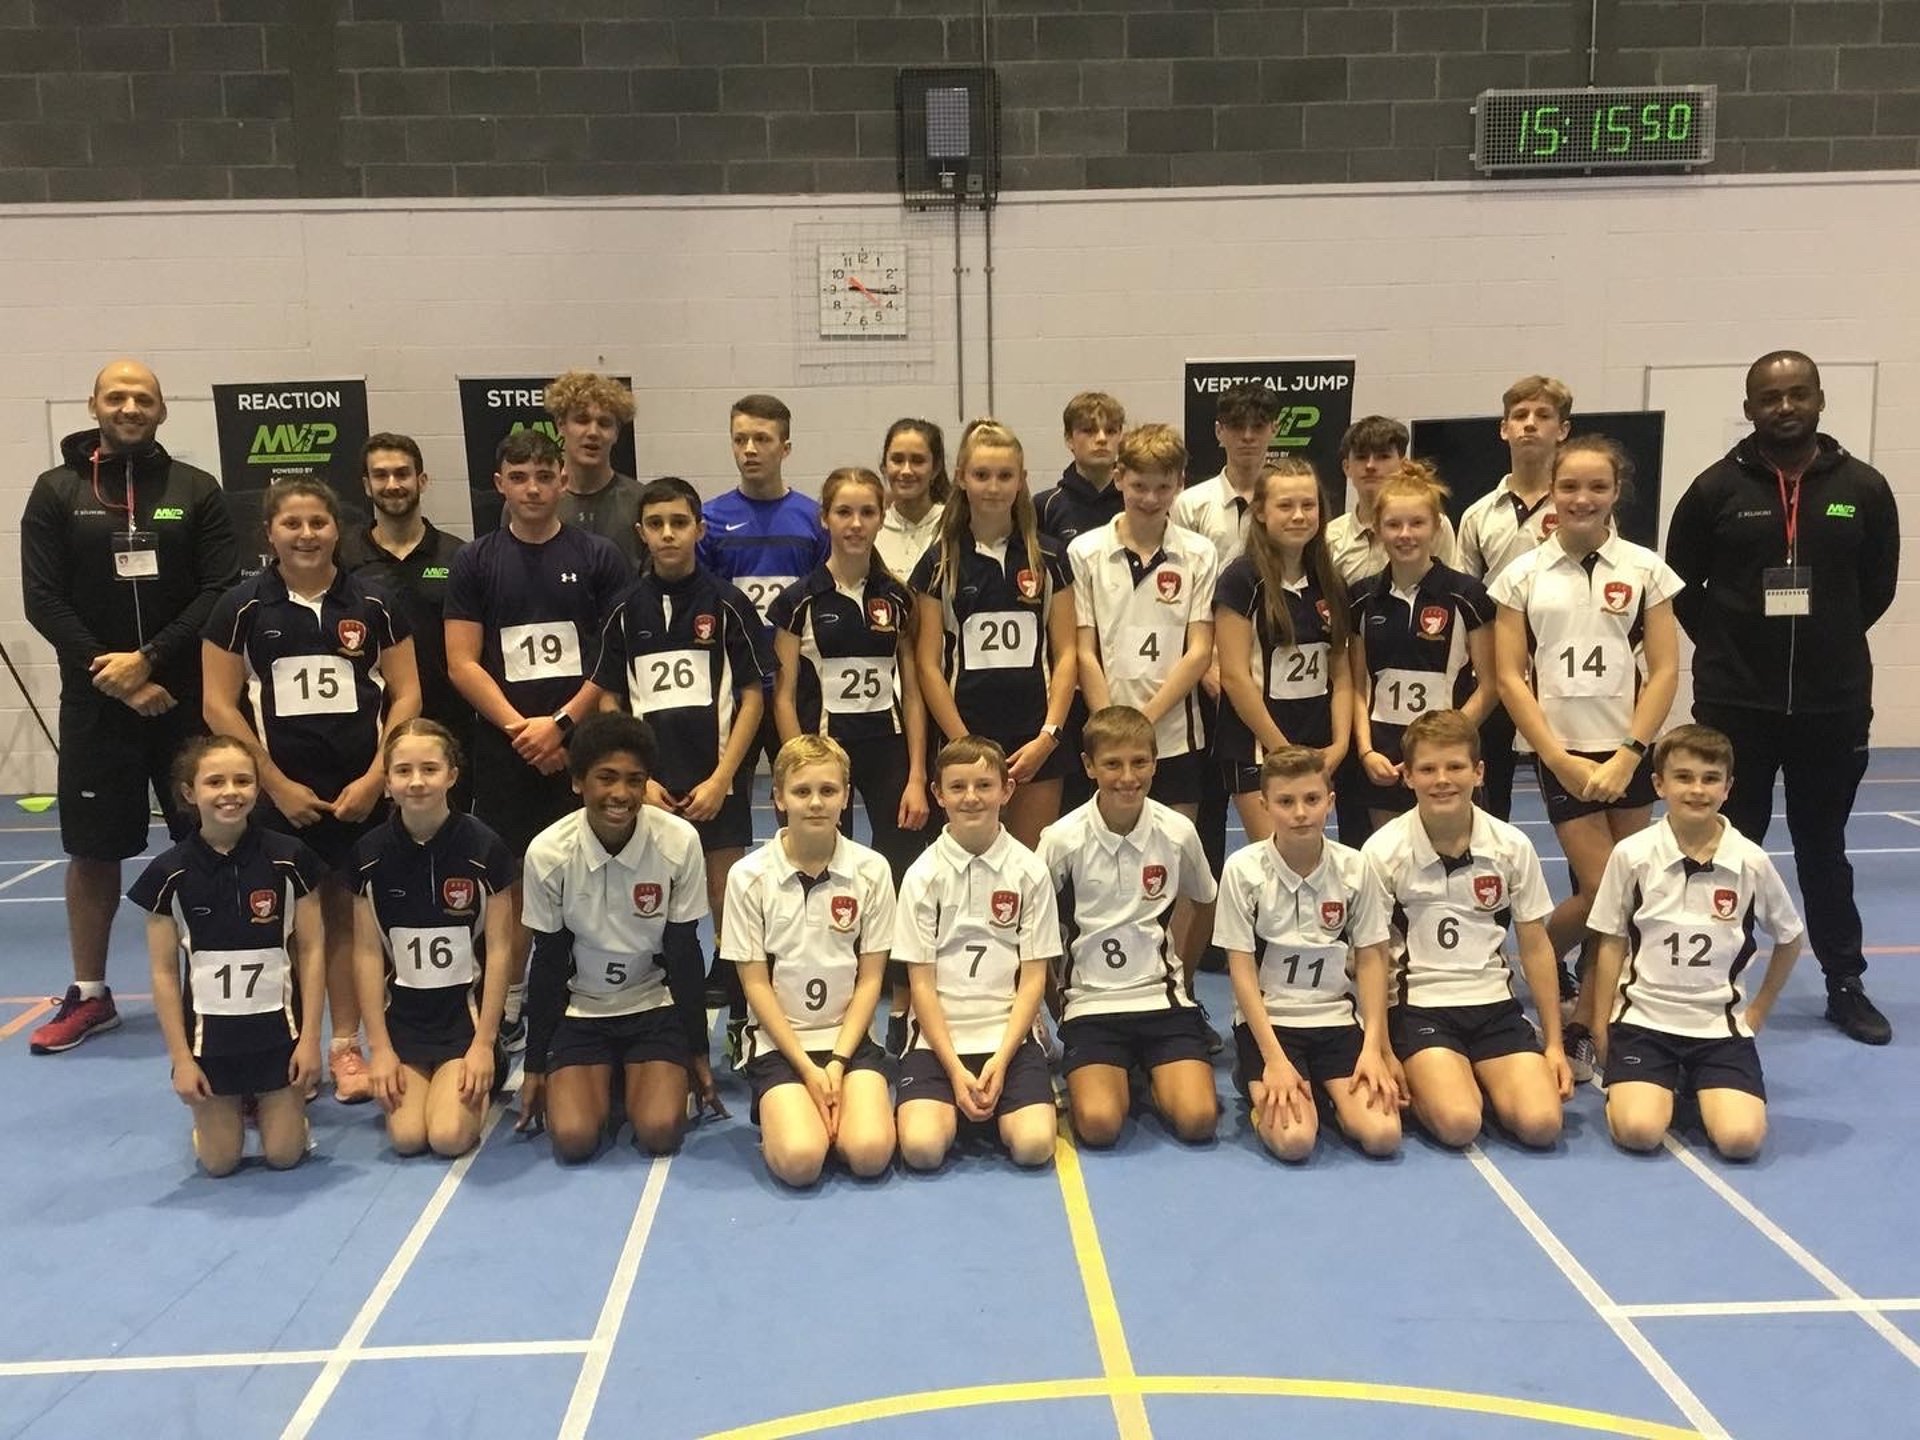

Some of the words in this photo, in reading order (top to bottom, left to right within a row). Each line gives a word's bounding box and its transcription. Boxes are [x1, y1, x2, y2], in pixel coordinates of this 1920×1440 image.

[1641, 104, 1692, 141] 50
[843, 257, 852, 267] 11
[857, 252, 868, 264] 12
[830, 284, 837, 295] 9
[832, 269, 845, 280] 10
[886, 268, 894, 280] 2
[833, 300, 841, 310] 8
[844, 311, 852, 322] 7
[875, 311, 882, 322] 5
[886, 300, 893, 309] 4
[860, 316, 868, 326] 6
[1291, 375, 1349, 391] JUMP
[238, 391, 341, 411] REACTION
[249, 423, 337, 454] MVP
[153, 508, 184, 520] MVP
[519, 634, 563, 666] 19
[979, 620, 1021, 651] 20
[1139, 632, 1160, 662] 4
[650, 658, 694, 693] 26
[1287, 651, 1320, 682] 24
[1559, 645, 1606, 678] 14
[292, 667, 340, 700] 15
[840, 668, 881, 699] 25
[1388, 682, 1427, 713] 13
[1436, 917, 1460, 949] 6
[406, 936, 453, 970] 16
[965, 945, 987, 978] 7
[1101, 938, 1127, 970] 8
[1663, 932, 1713, 967] 12
[214, 963, 264, 999] 17
[605, 962, 627, 985] 5
[1282, 955, 1325, 987] 11
[805, 978, 828, 1012] 9
